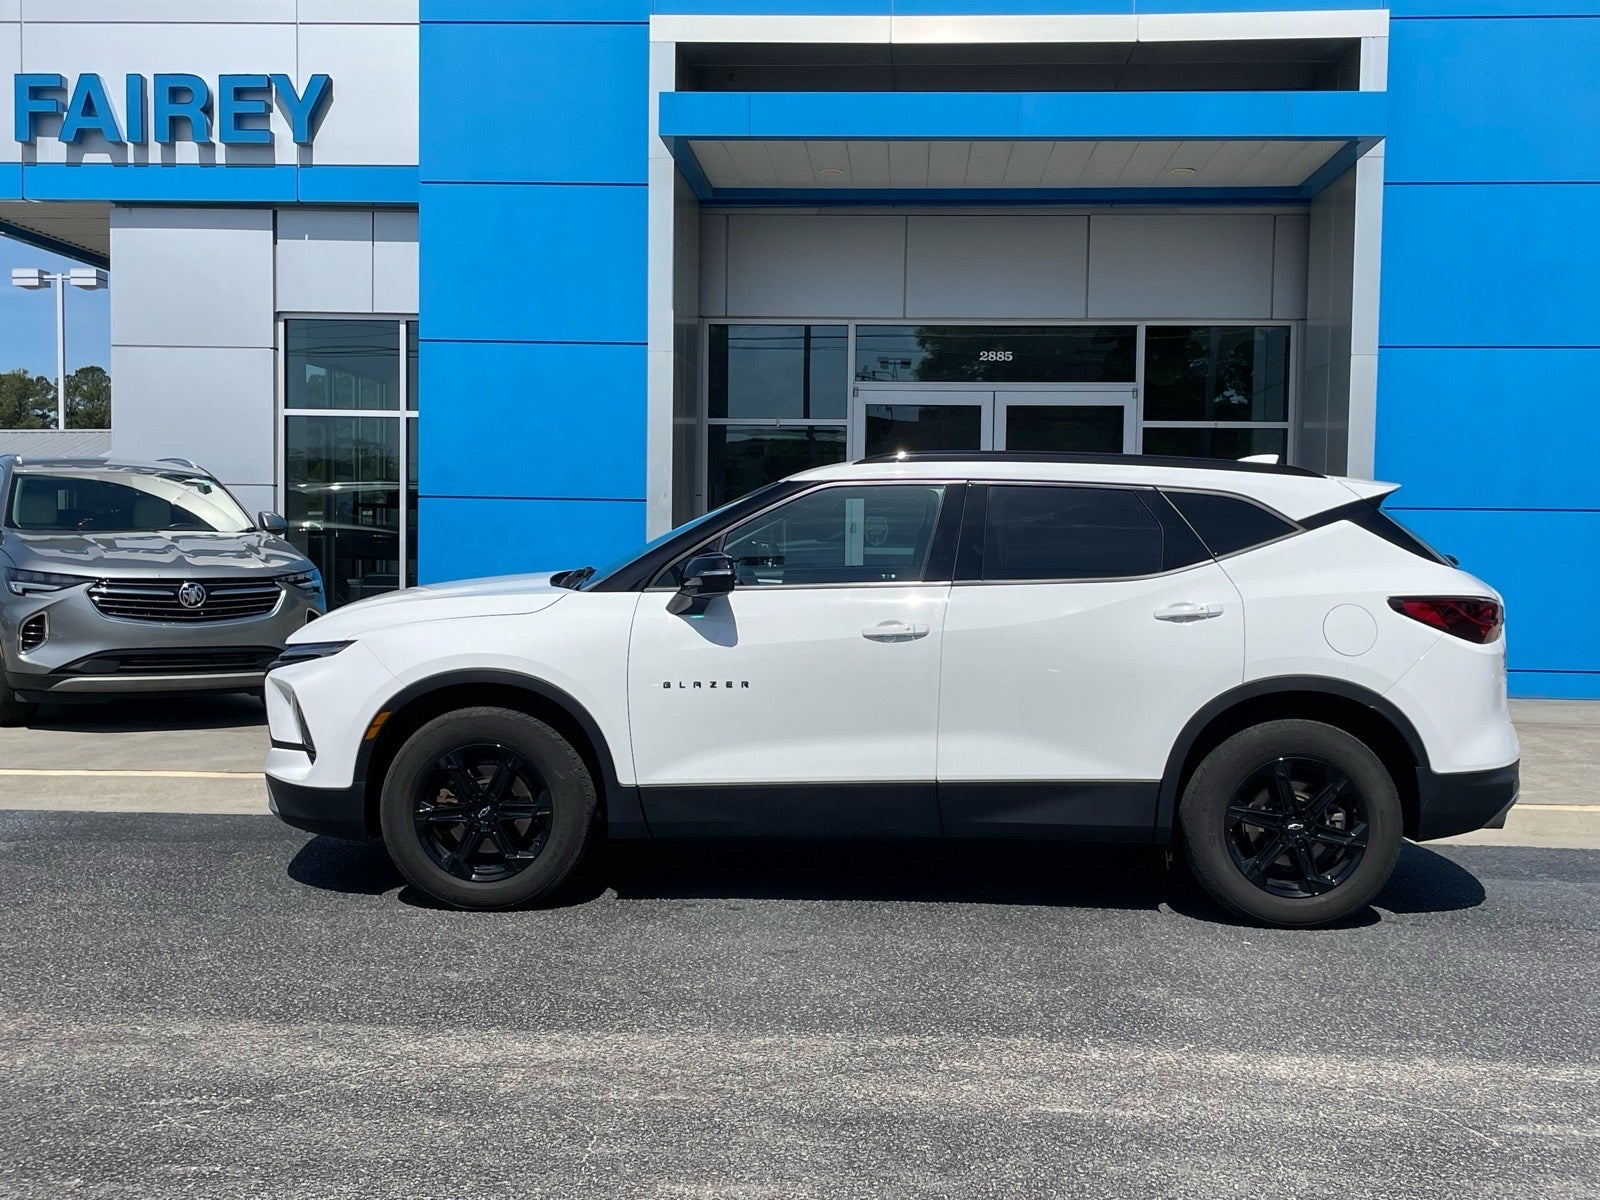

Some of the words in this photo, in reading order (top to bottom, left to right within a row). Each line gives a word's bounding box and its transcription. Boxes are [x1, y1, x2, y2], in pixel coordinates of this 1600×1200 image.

[14, 73, 332, 145] FAIREY
[979, 351, 1013, 361] 2885
[663, 681, 749, 689] BLAZER
